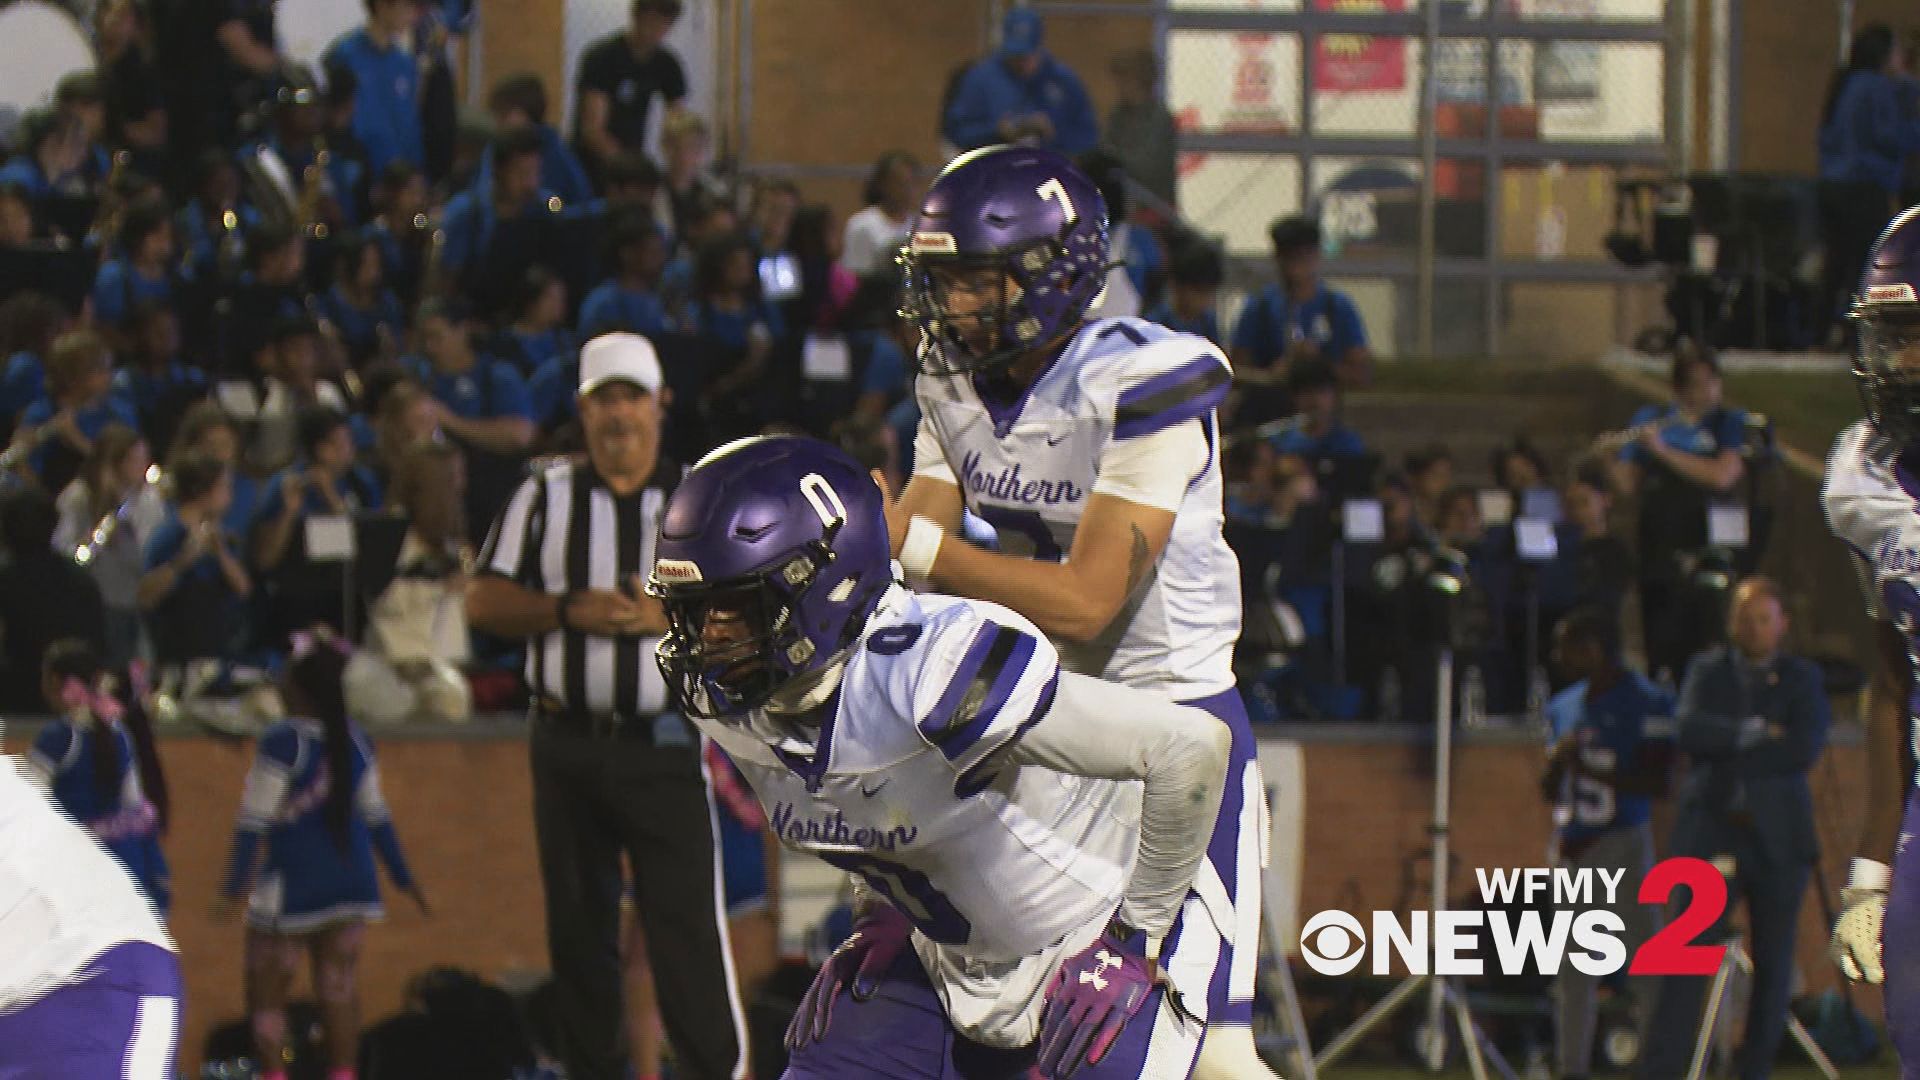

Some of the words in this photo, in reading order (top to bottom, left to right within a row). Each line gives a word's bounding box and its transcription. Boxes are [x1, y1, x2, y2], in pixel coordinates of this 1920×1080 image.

[1036, 178, 1076, 223] 7
[1097, 321, 1150, 346] 7
[961, 450, 1083, 504] Northern
[866, 624, 923, 656] 0
[770, 801, 917, 850] Northern
